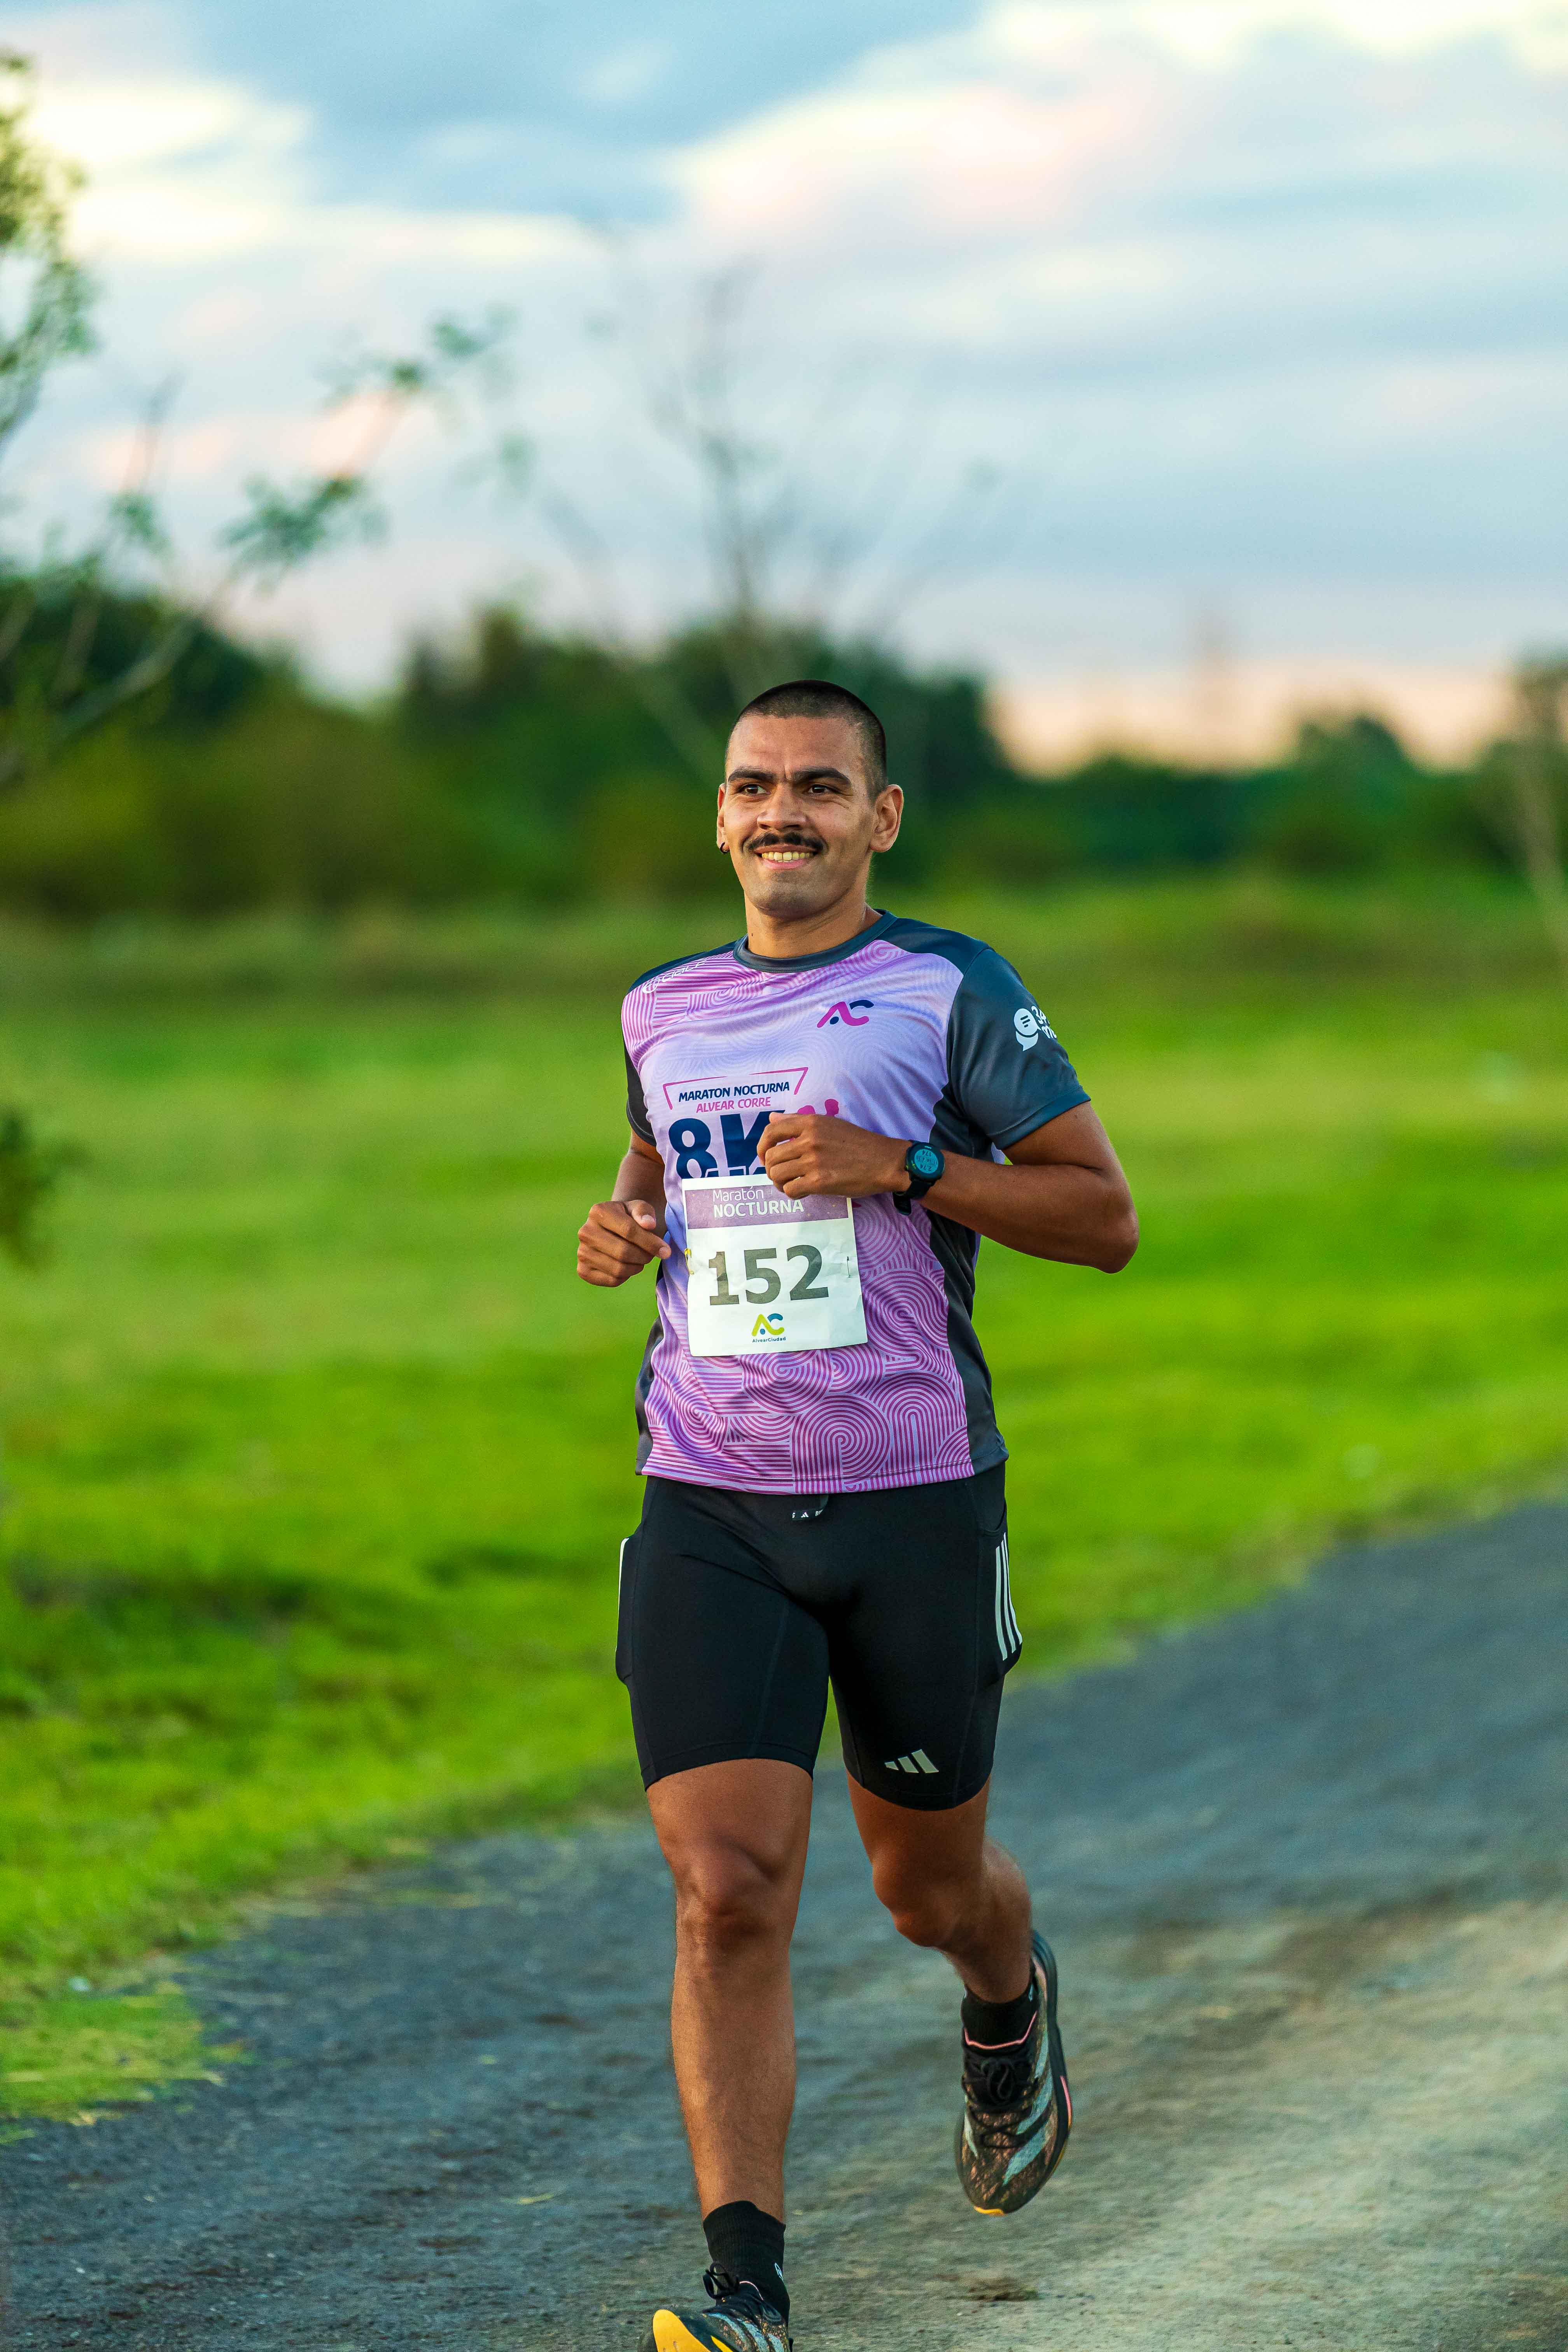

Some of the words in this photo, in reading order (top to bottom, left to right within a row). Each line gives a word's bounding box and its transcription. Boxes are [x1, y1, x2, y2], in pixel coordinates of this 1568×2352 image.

[679, 1087, 730, 1102] MARATON
[734, 1082, 790, 1096] NOCTURNA
[696, 1100, 734, 1113] ALVEAR
[738, 1097, 771, 1108] CORRE
[712, 1186, 764, 1202] Maratón
[713, 1199, 804, 1218] NOCTURNA
[709, 1245, 829, 1306] 152
